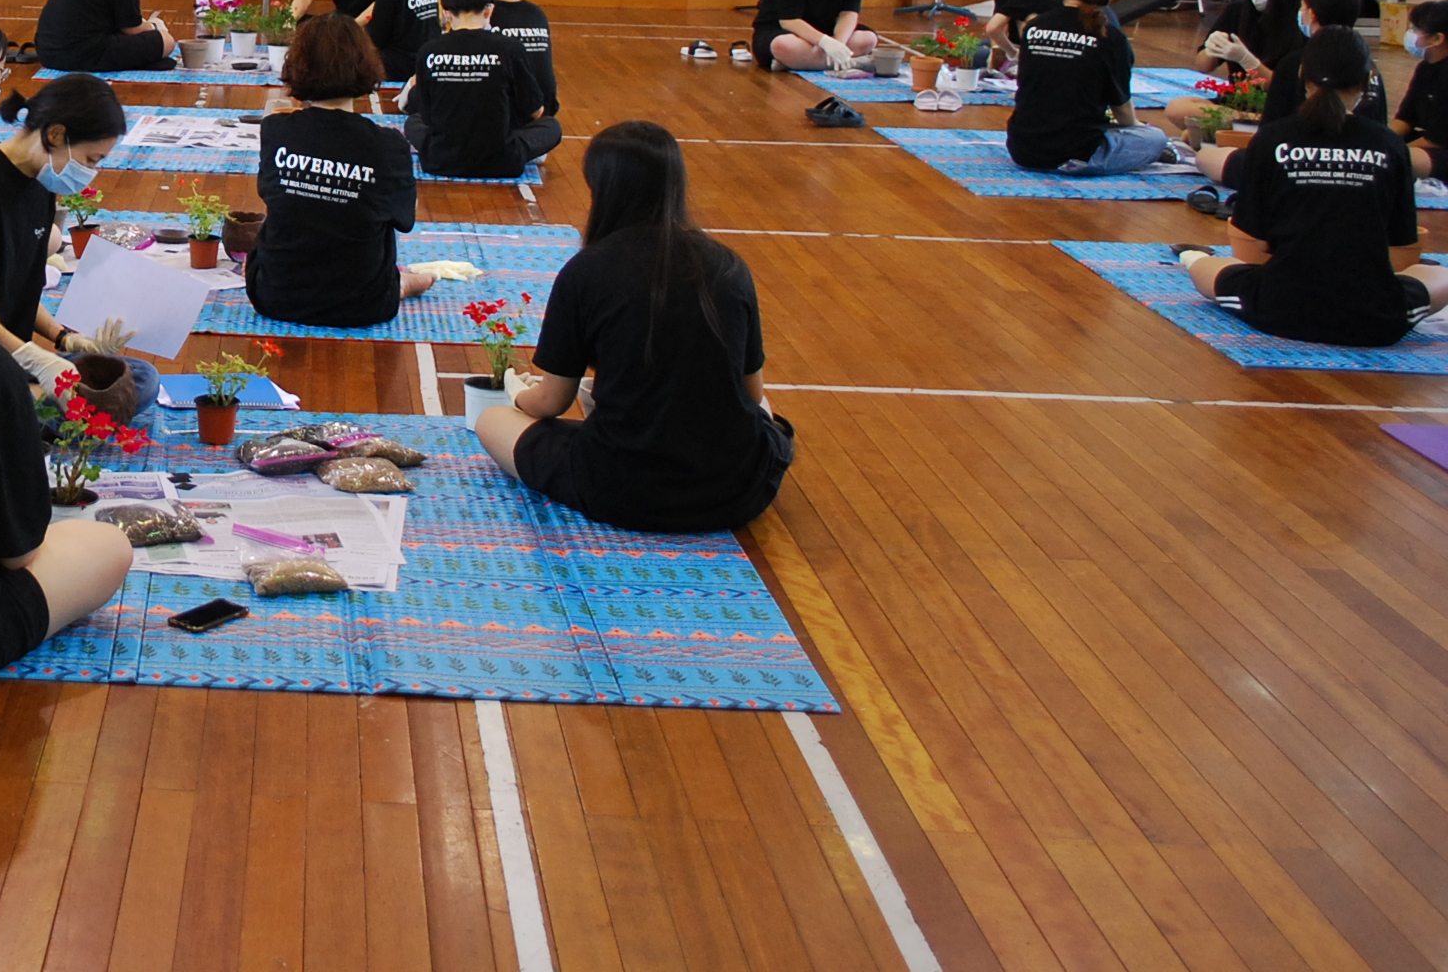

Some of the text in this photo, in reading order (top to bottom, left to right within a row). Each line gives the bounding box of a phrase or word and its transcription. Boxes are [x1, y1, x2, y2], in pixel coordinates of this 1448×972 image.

[1026, 26, 1097, 46] COVERNAT
[426, 53, 498, 68] COVERNAT
[274, 146, 374, 182] COVERNAT
[1274, 142, 1386, 166] COVERNAT
